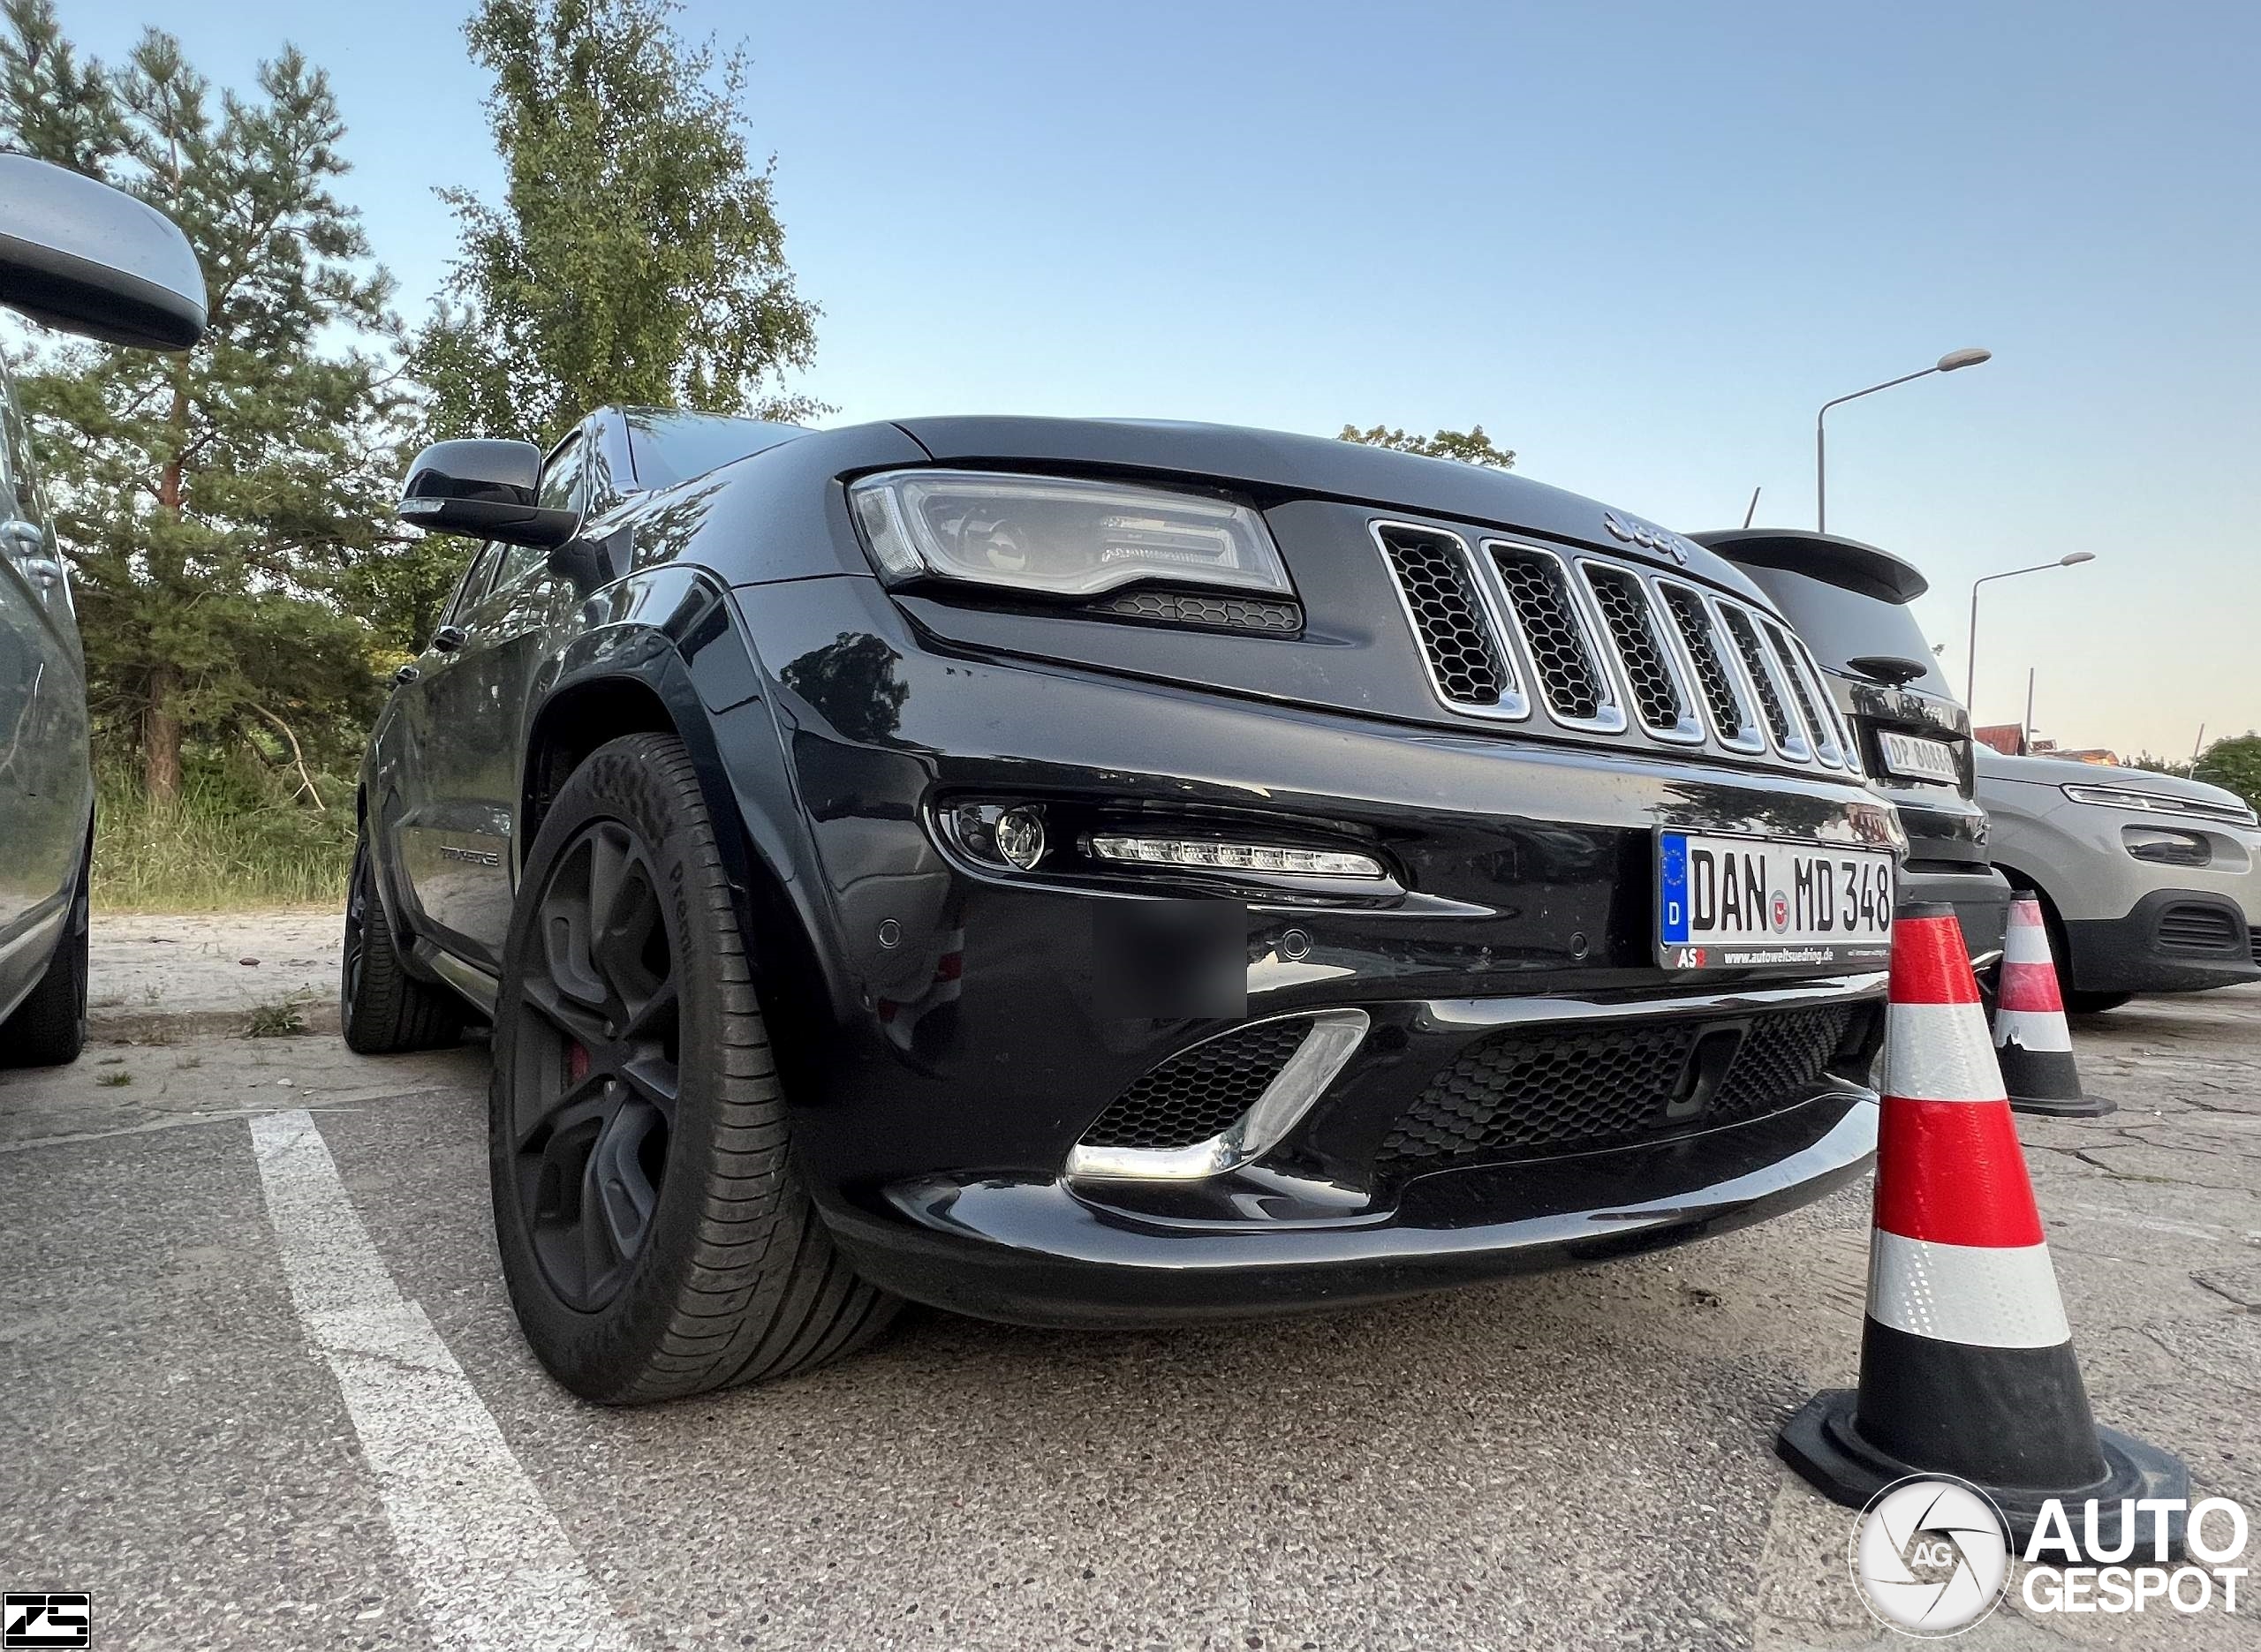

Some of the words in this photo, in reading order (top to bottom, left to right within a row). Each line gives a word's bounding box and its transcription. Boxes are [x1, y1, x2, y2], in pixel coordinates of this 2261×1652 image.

[1604, 512, 1689, 565] Jeep
[1691, 849, 1766, 931] DAN
[1795, 857, 1834, 932] MD
[1841, 862, 1890, 932] 348
[1668, 901, 1680, 925] D
[1724, 947, 1834, 965] www.autoweltsuedring.de
